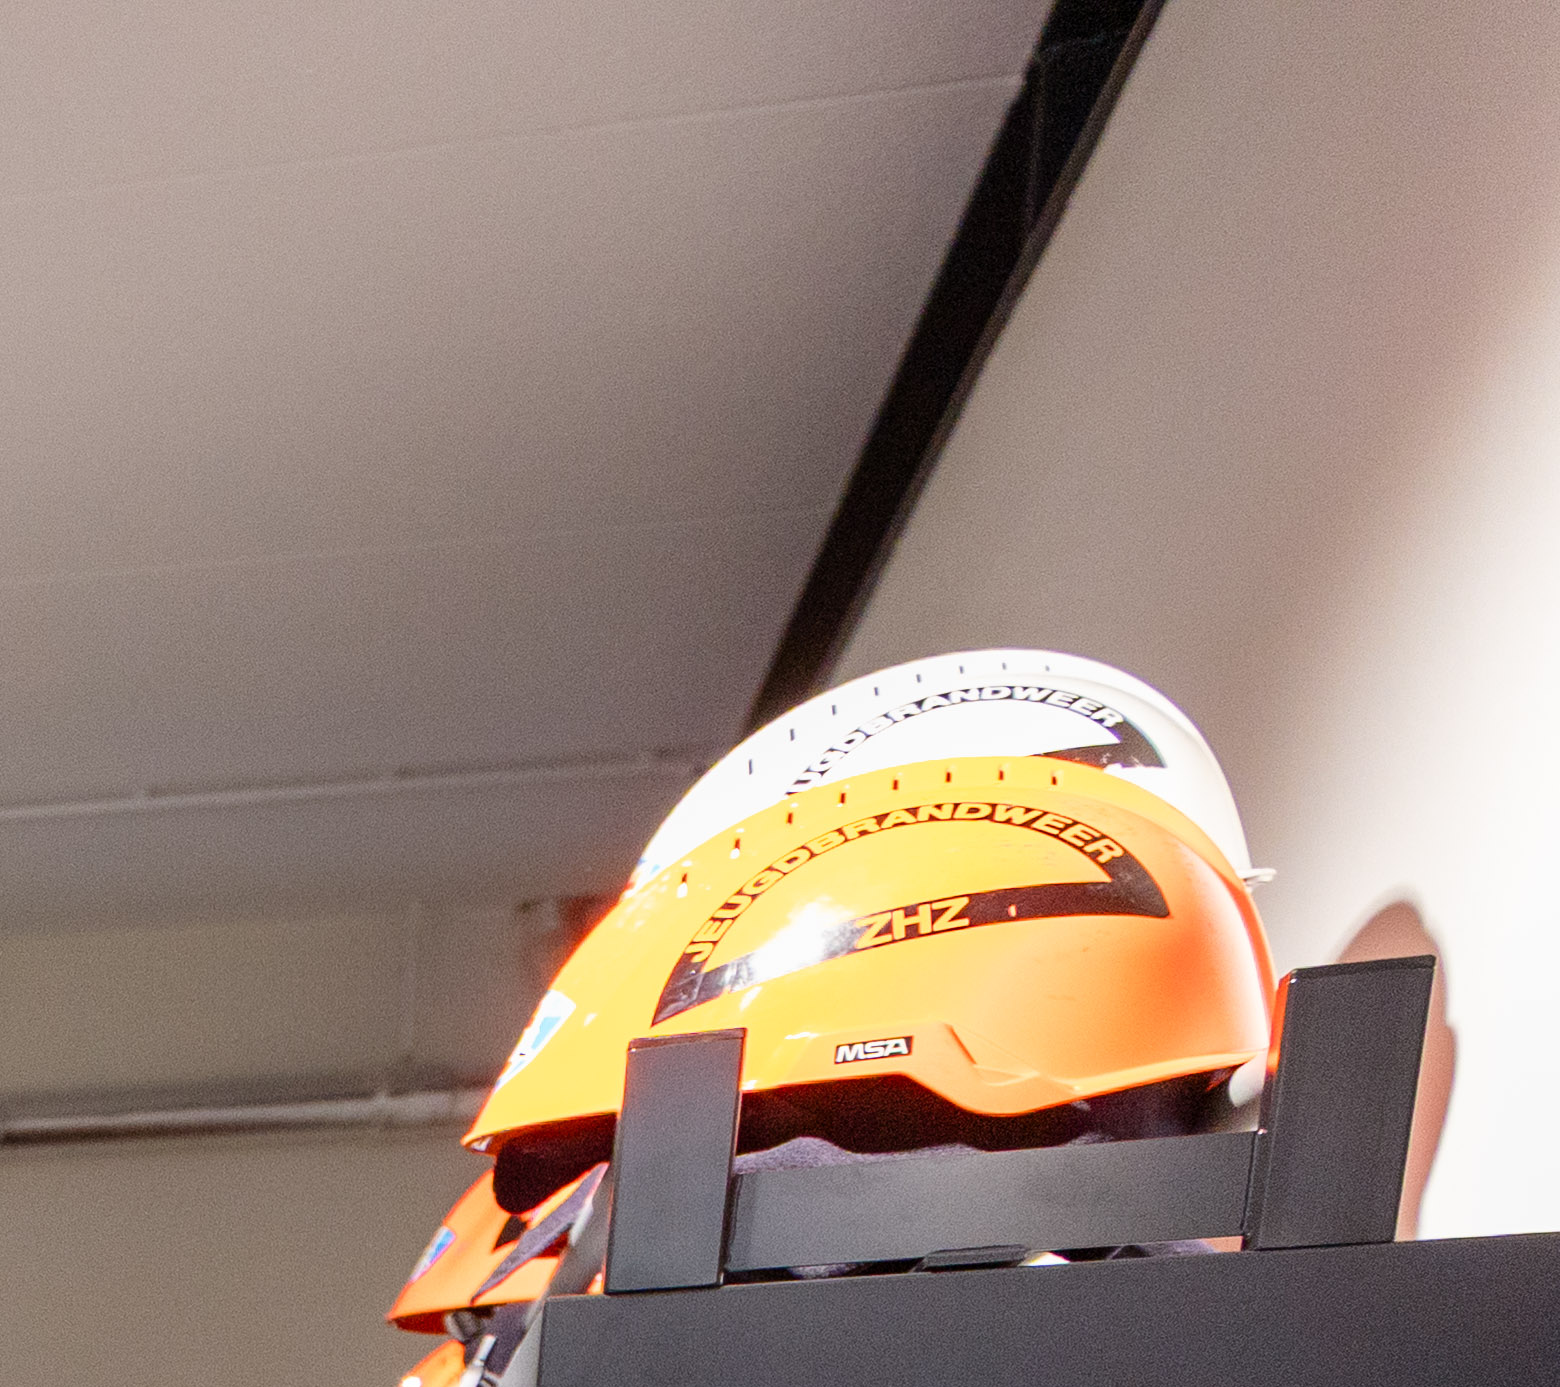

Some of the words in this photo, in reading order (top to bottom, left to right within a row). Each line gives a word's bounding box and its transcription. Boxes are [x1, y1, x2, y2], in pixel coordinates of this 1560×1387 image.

[787, 686, 1125, 797] UGDBRANDWEER
[686, 802, 1124, 962] JEUGDBRANDWEER
[855, 896, 970, 950] ZHZ
[836, 1037, 910, 1064] MSA
